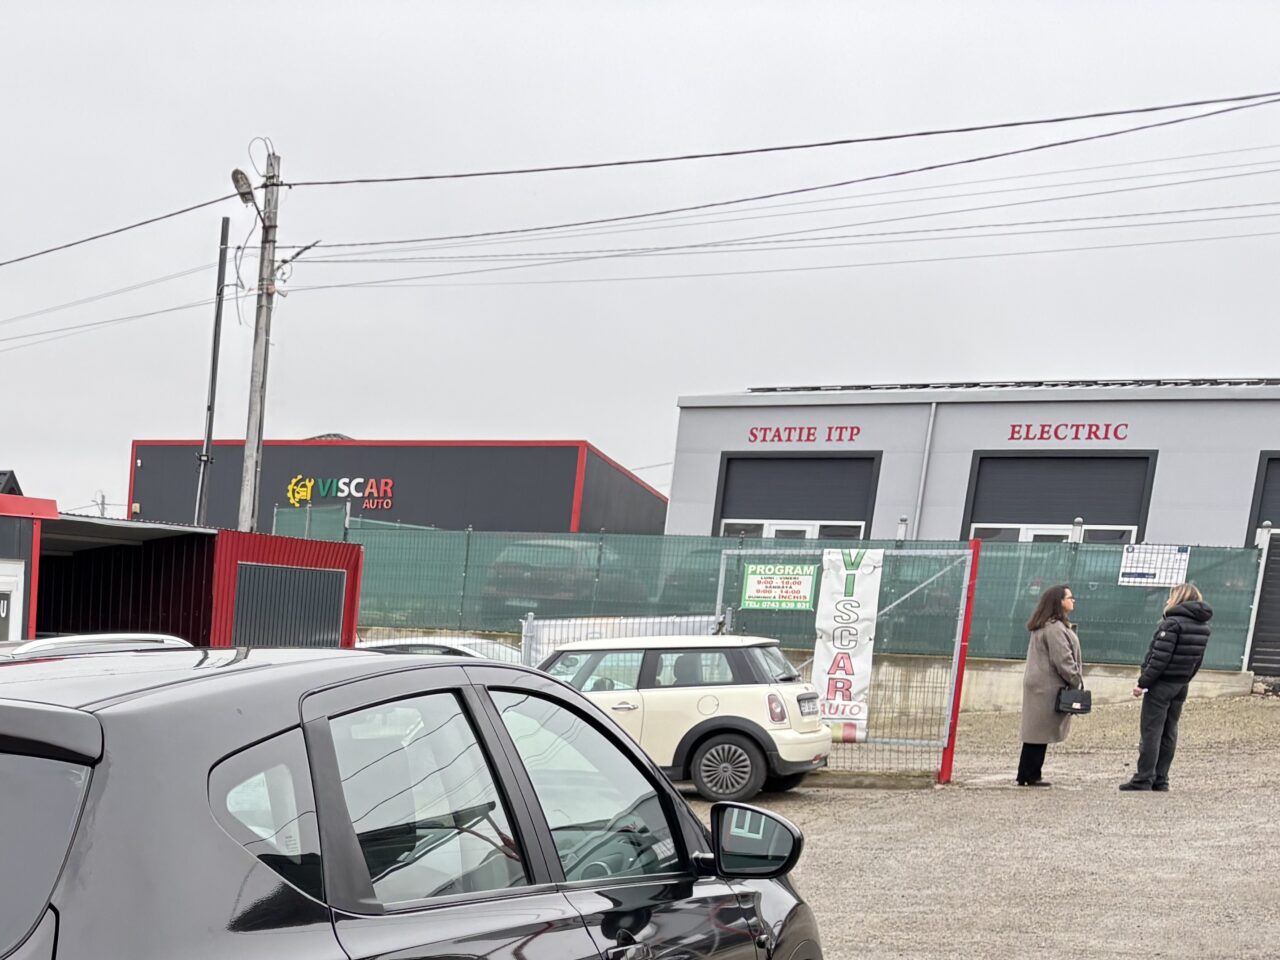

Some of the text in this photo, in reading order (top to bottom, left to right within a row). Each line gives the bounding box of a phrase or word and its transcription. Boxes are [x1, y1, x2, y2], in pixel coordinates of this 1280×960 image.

[748, 426, 861, 443] STATIE ITP
[1008, 423, 1129, 441] ELECTRIC
[318, 477, 394, 498] VISCAR
[362, 499, 392, 509] AUTO
[748, 564, 815, 575] PROGRAM
[826, 549, 868, 701] VISCAR
